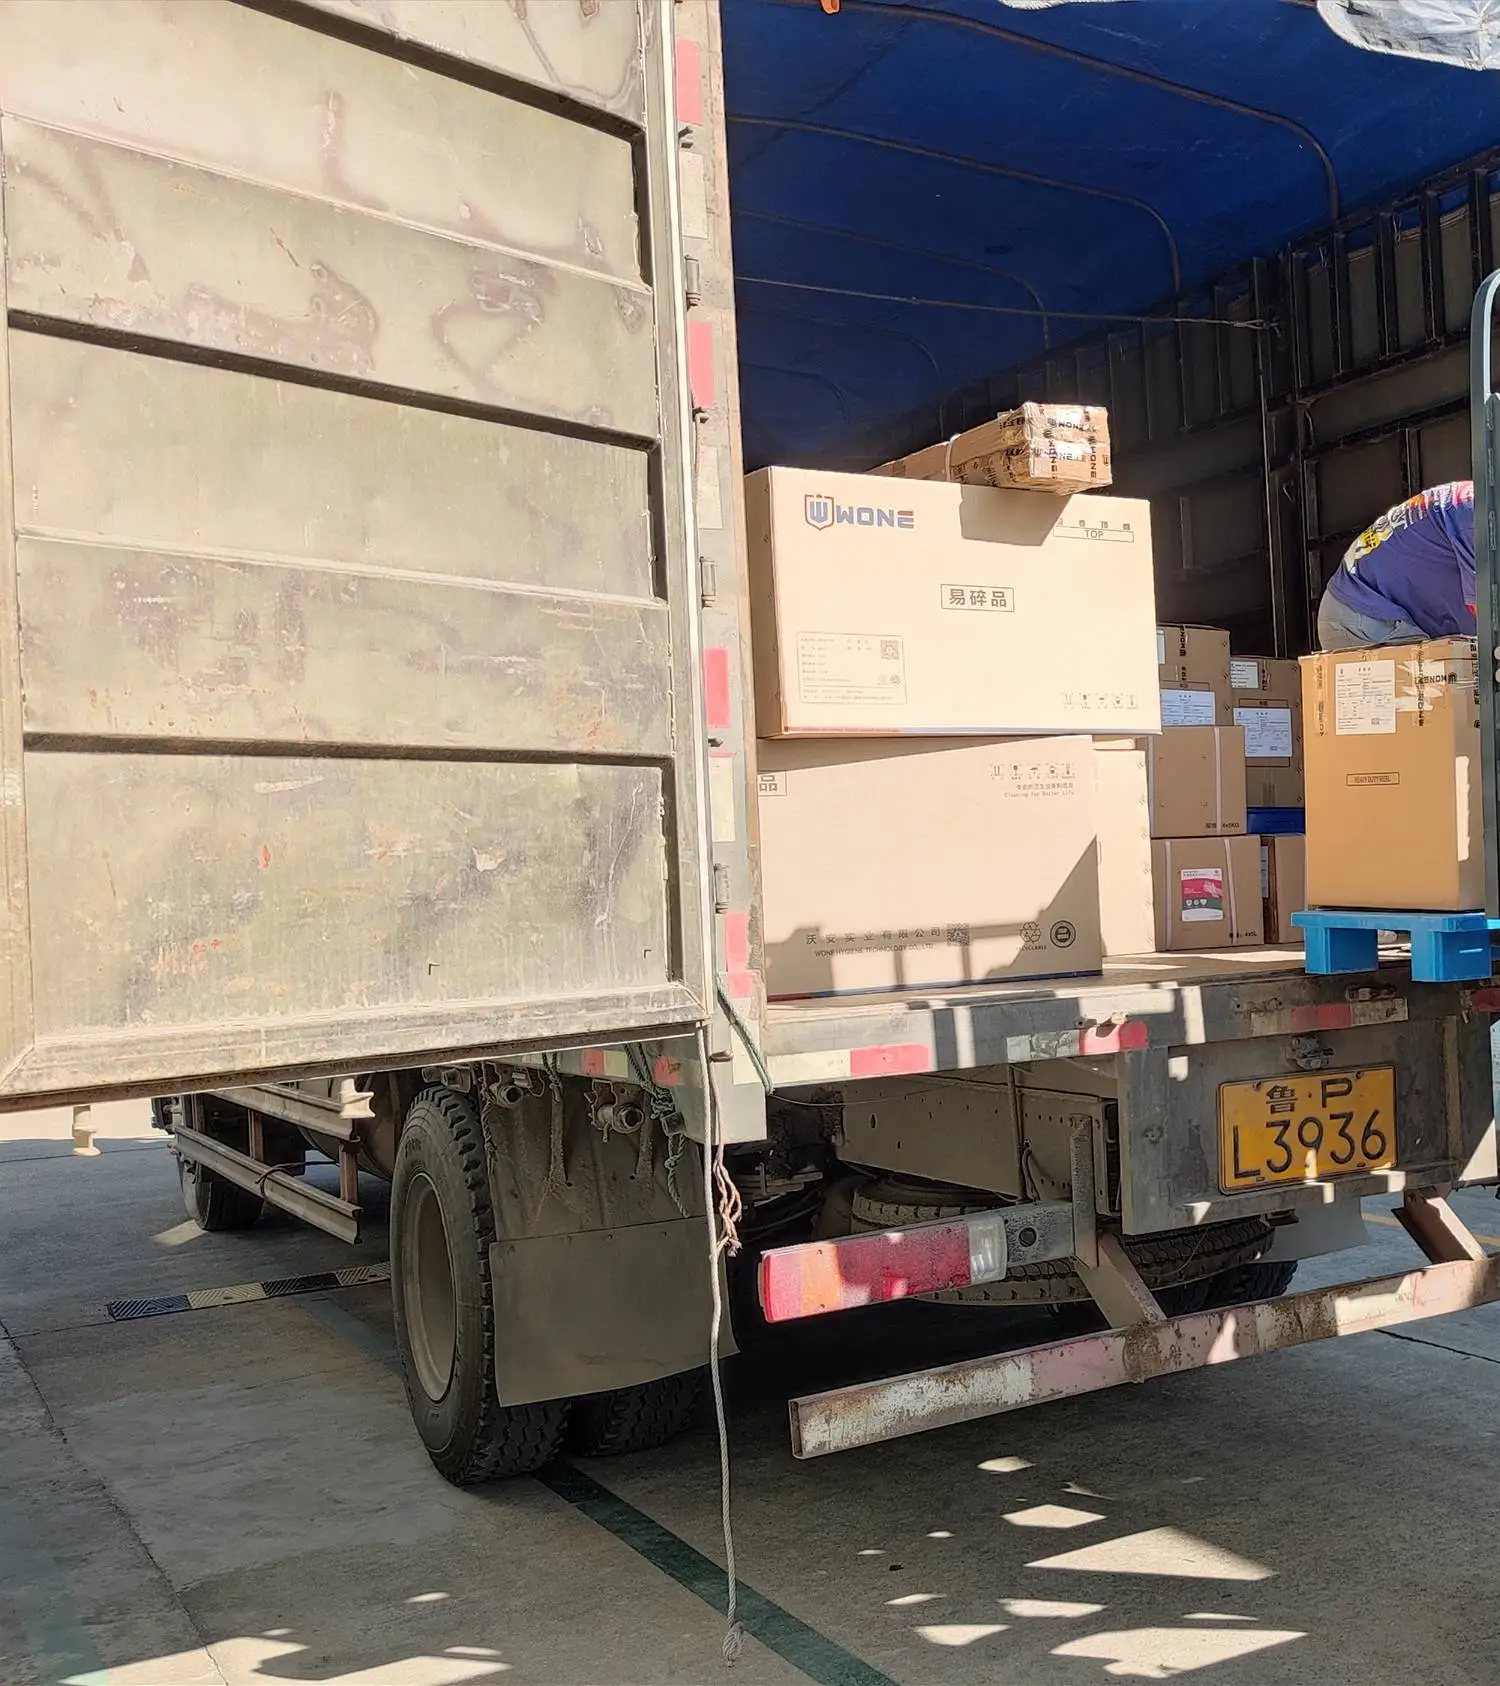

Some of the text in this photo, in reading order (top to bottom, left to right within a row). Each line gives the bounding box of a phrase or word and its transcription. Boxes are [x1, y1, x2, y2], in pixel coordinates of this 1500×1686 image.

[836, 505, 914, 529] WONE
[1084, 529, 1104, 539] TOP
[949, 588, 1008, 608] 易碎品
[1233, 1109, 1387, 1179] L3936
